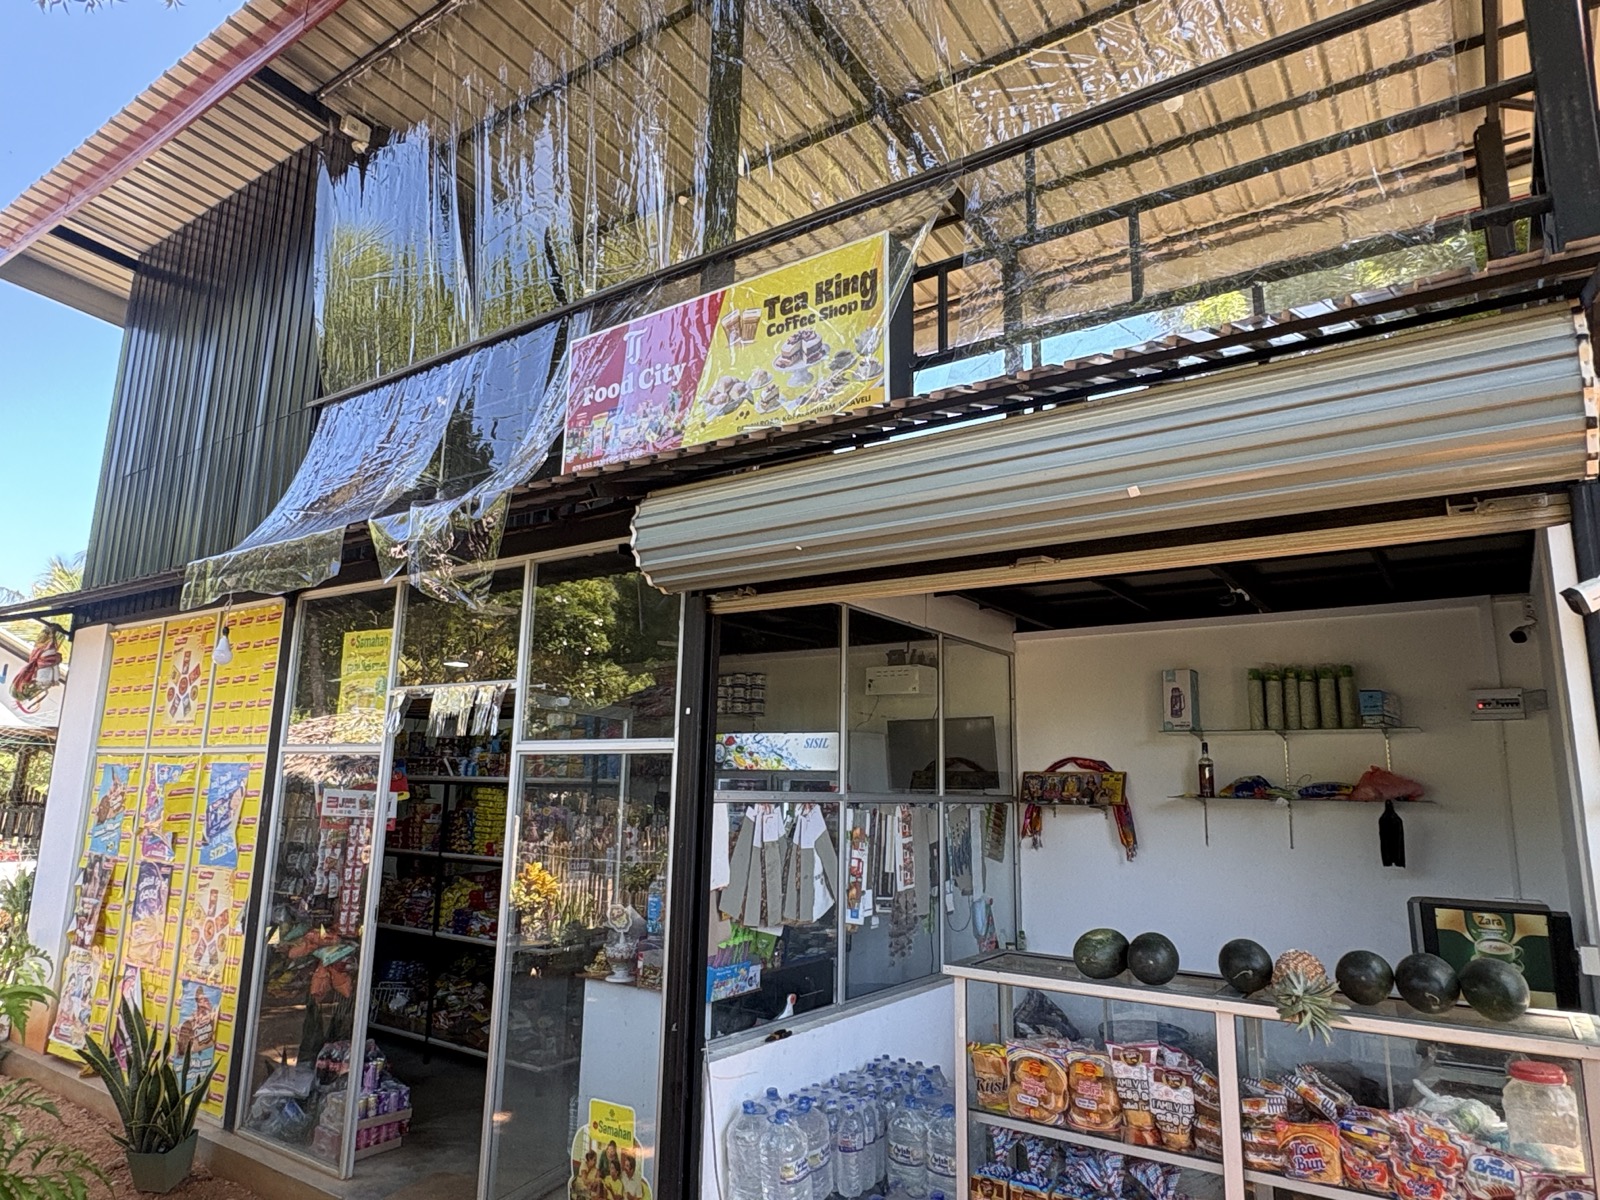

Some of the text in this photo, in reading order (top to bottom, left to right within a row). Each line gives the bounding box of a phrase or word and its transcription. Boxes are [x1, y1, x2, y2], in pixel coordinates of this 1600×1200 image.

[763, 268, 878, 321] Tea King
[766, 300, 859, 338] Coffee Shop
[582, 361, 687, 407] Food City
[356, 633, 389, 649] Samahan
[803, 737, 829, 749] SISIL
[1477, 915, 1503, 927] Zara
[1116, 1077, 1140, 1090] AMILY
[598, 1119, 632, 1141] Samahan
[1289, 1140, 1317, 1156] Tea
[1293, 1155, 1325, 1172] Bun
[1473, 1158, 1515, 1182] Bread
